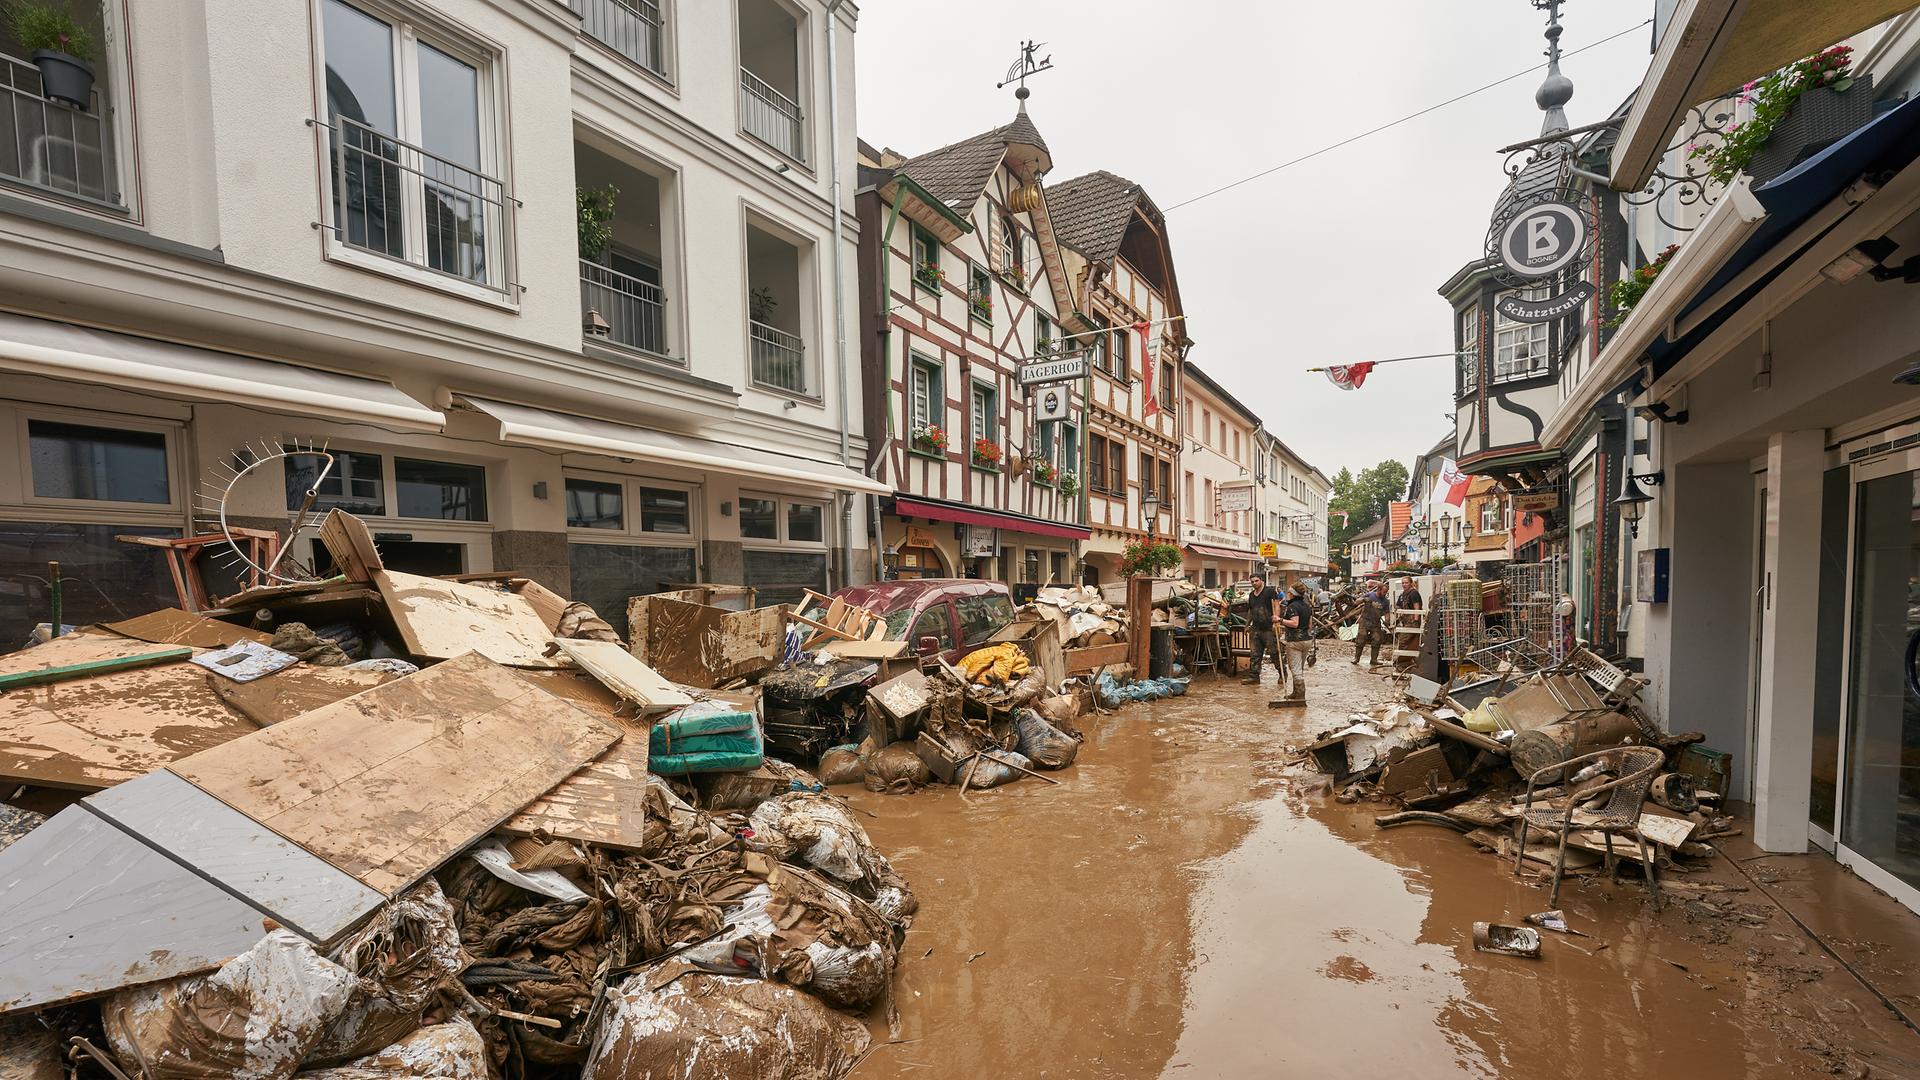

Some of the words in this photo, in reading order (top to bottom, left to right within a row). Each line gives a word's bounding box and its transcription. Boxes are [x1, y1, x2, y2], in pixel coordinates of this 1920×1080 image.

[1527, 215, 1560, 258] B
[1526, 254, 1558, 265] BOGNER
[1504, 290, 1587, 318] Schatztruhe
[1022, 361, 1082, 381] JÄGERHOF
